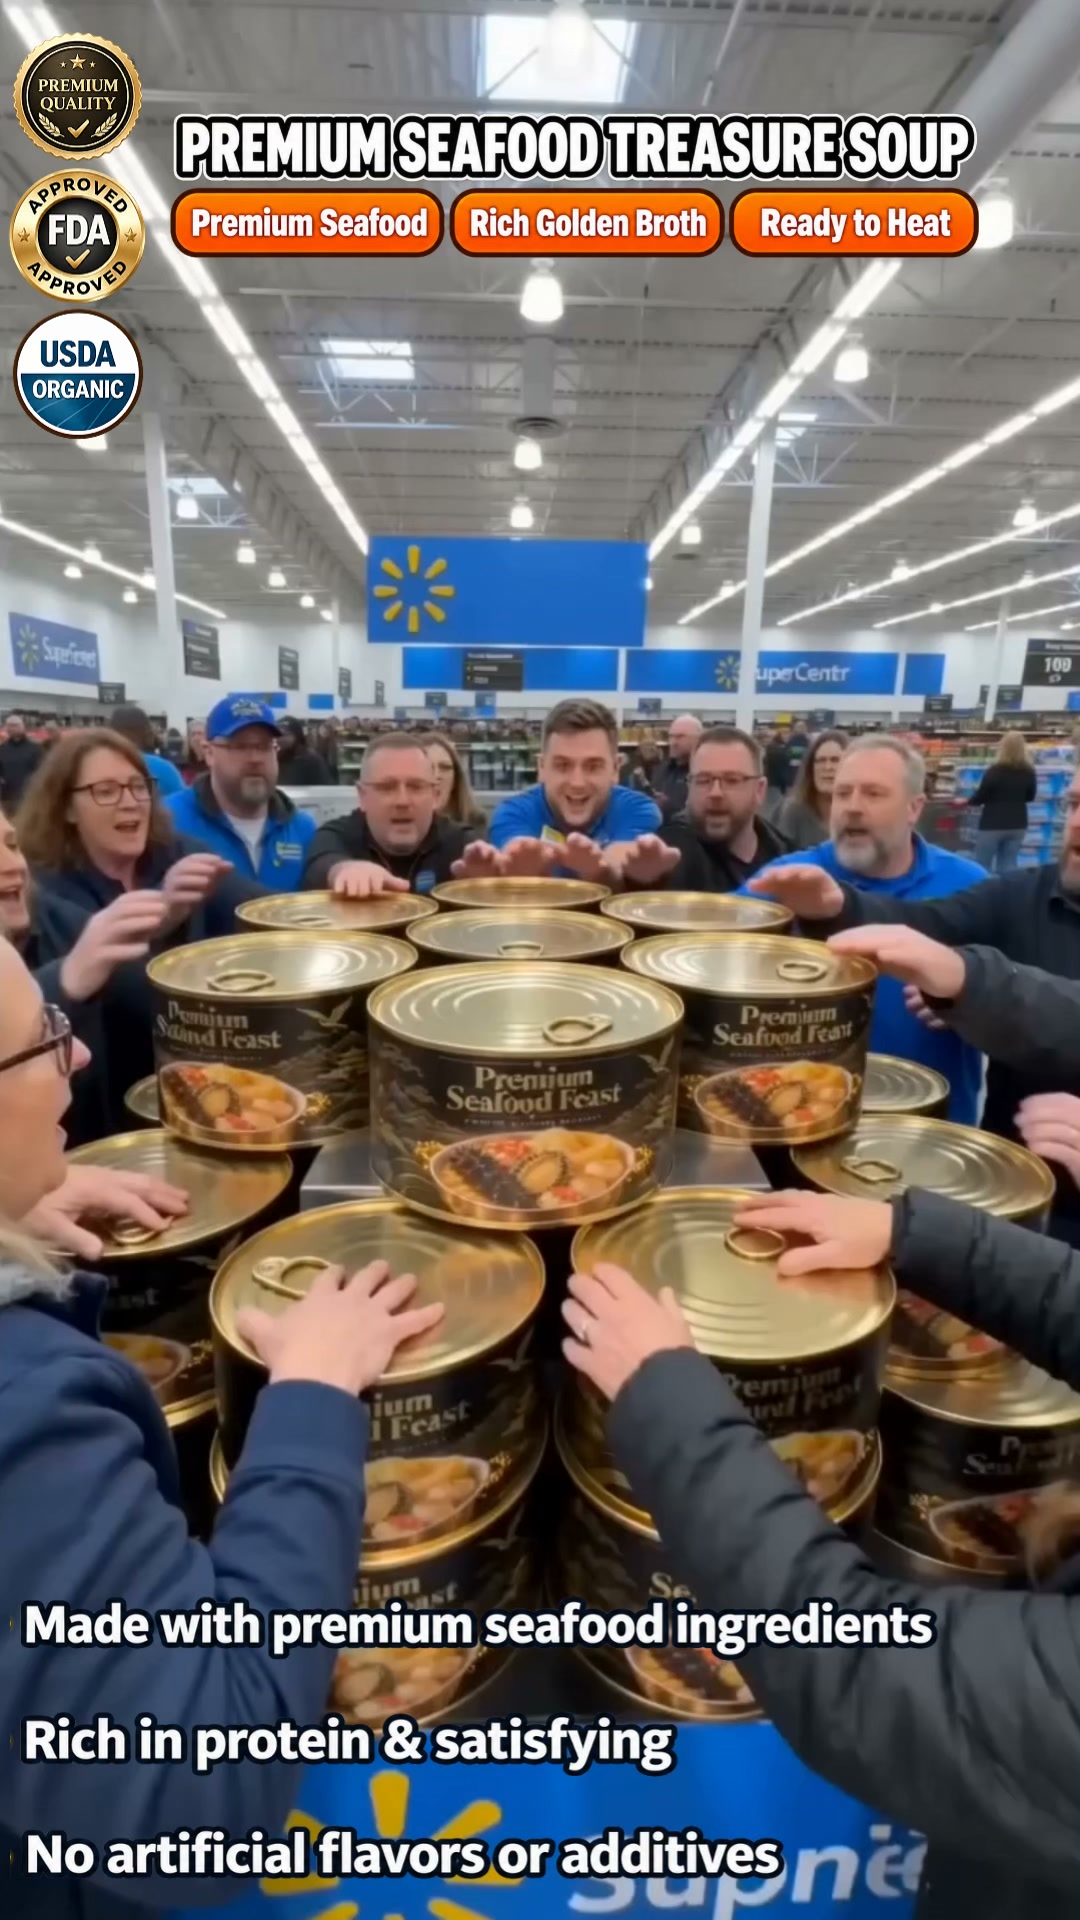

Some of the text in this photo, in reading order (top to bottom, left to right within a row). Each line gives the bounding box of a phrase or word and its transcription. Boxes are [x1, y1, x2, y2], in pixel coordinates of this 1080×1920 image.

[755, 662, 851, 688] uperCentr
[474, 1065, 594, 1091] Premium
[446, 1082, 622, 1114] Seafood Feast
